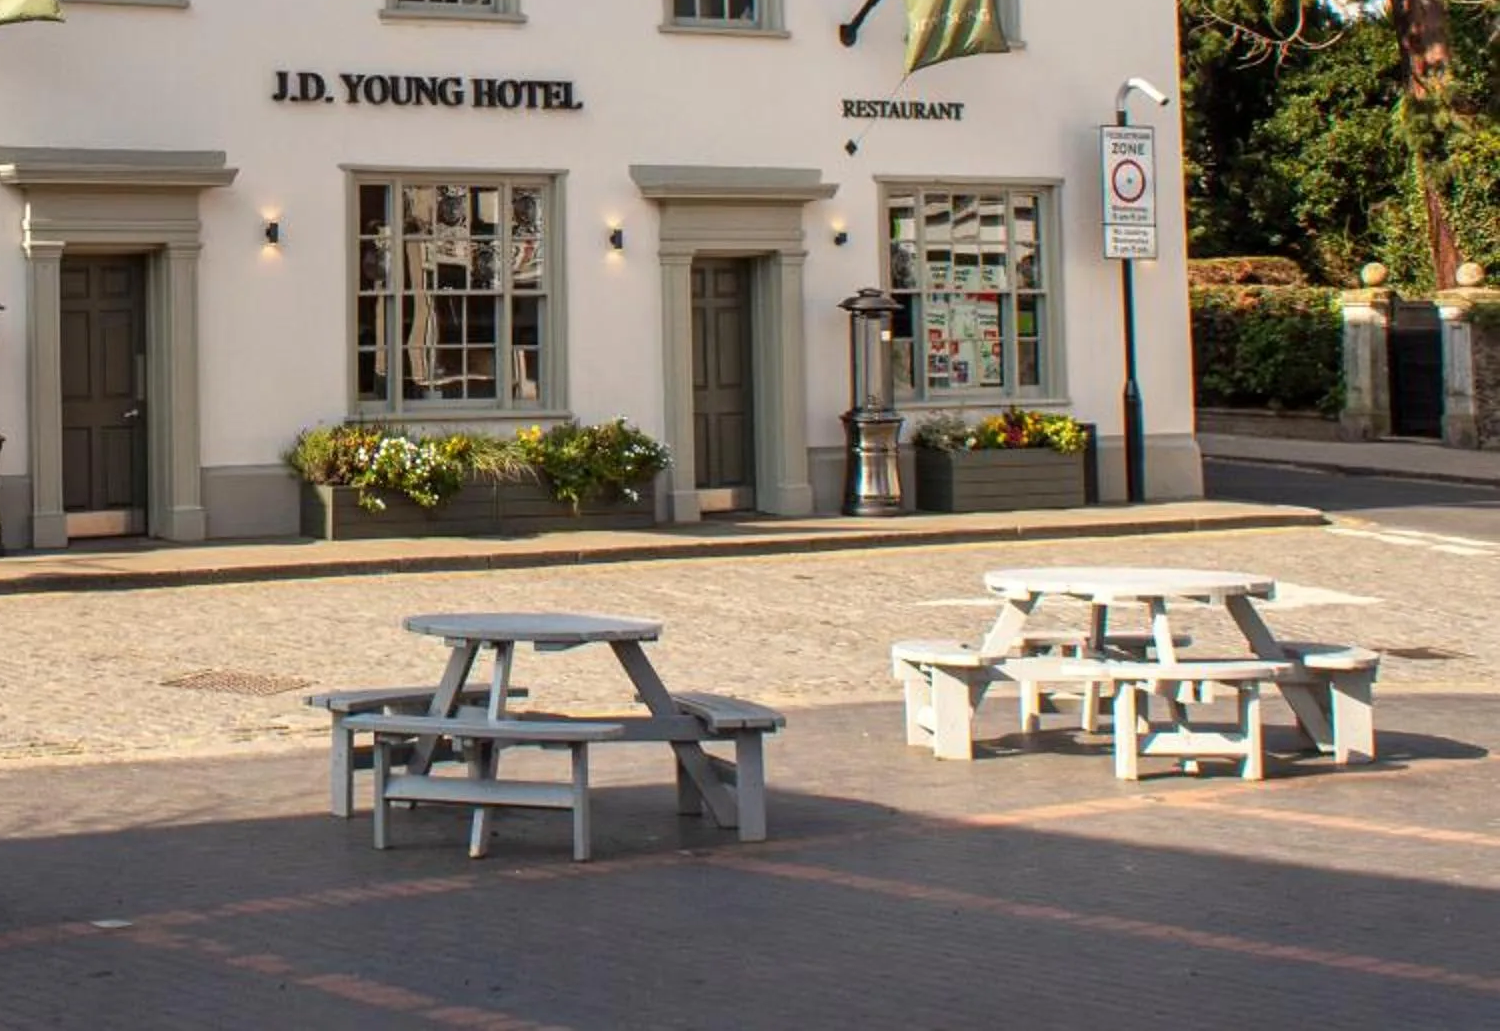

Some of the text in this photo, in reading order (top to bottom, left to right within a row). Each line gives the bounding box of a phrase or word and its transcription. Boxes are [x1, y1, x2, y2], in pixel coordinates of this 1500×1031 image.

[272, 71, 583, 110] J.D. YOUNG HOTEL
[841, 99, 965, 121] RESTAURANT
[1111, 142, 1145, 156] ZONE
